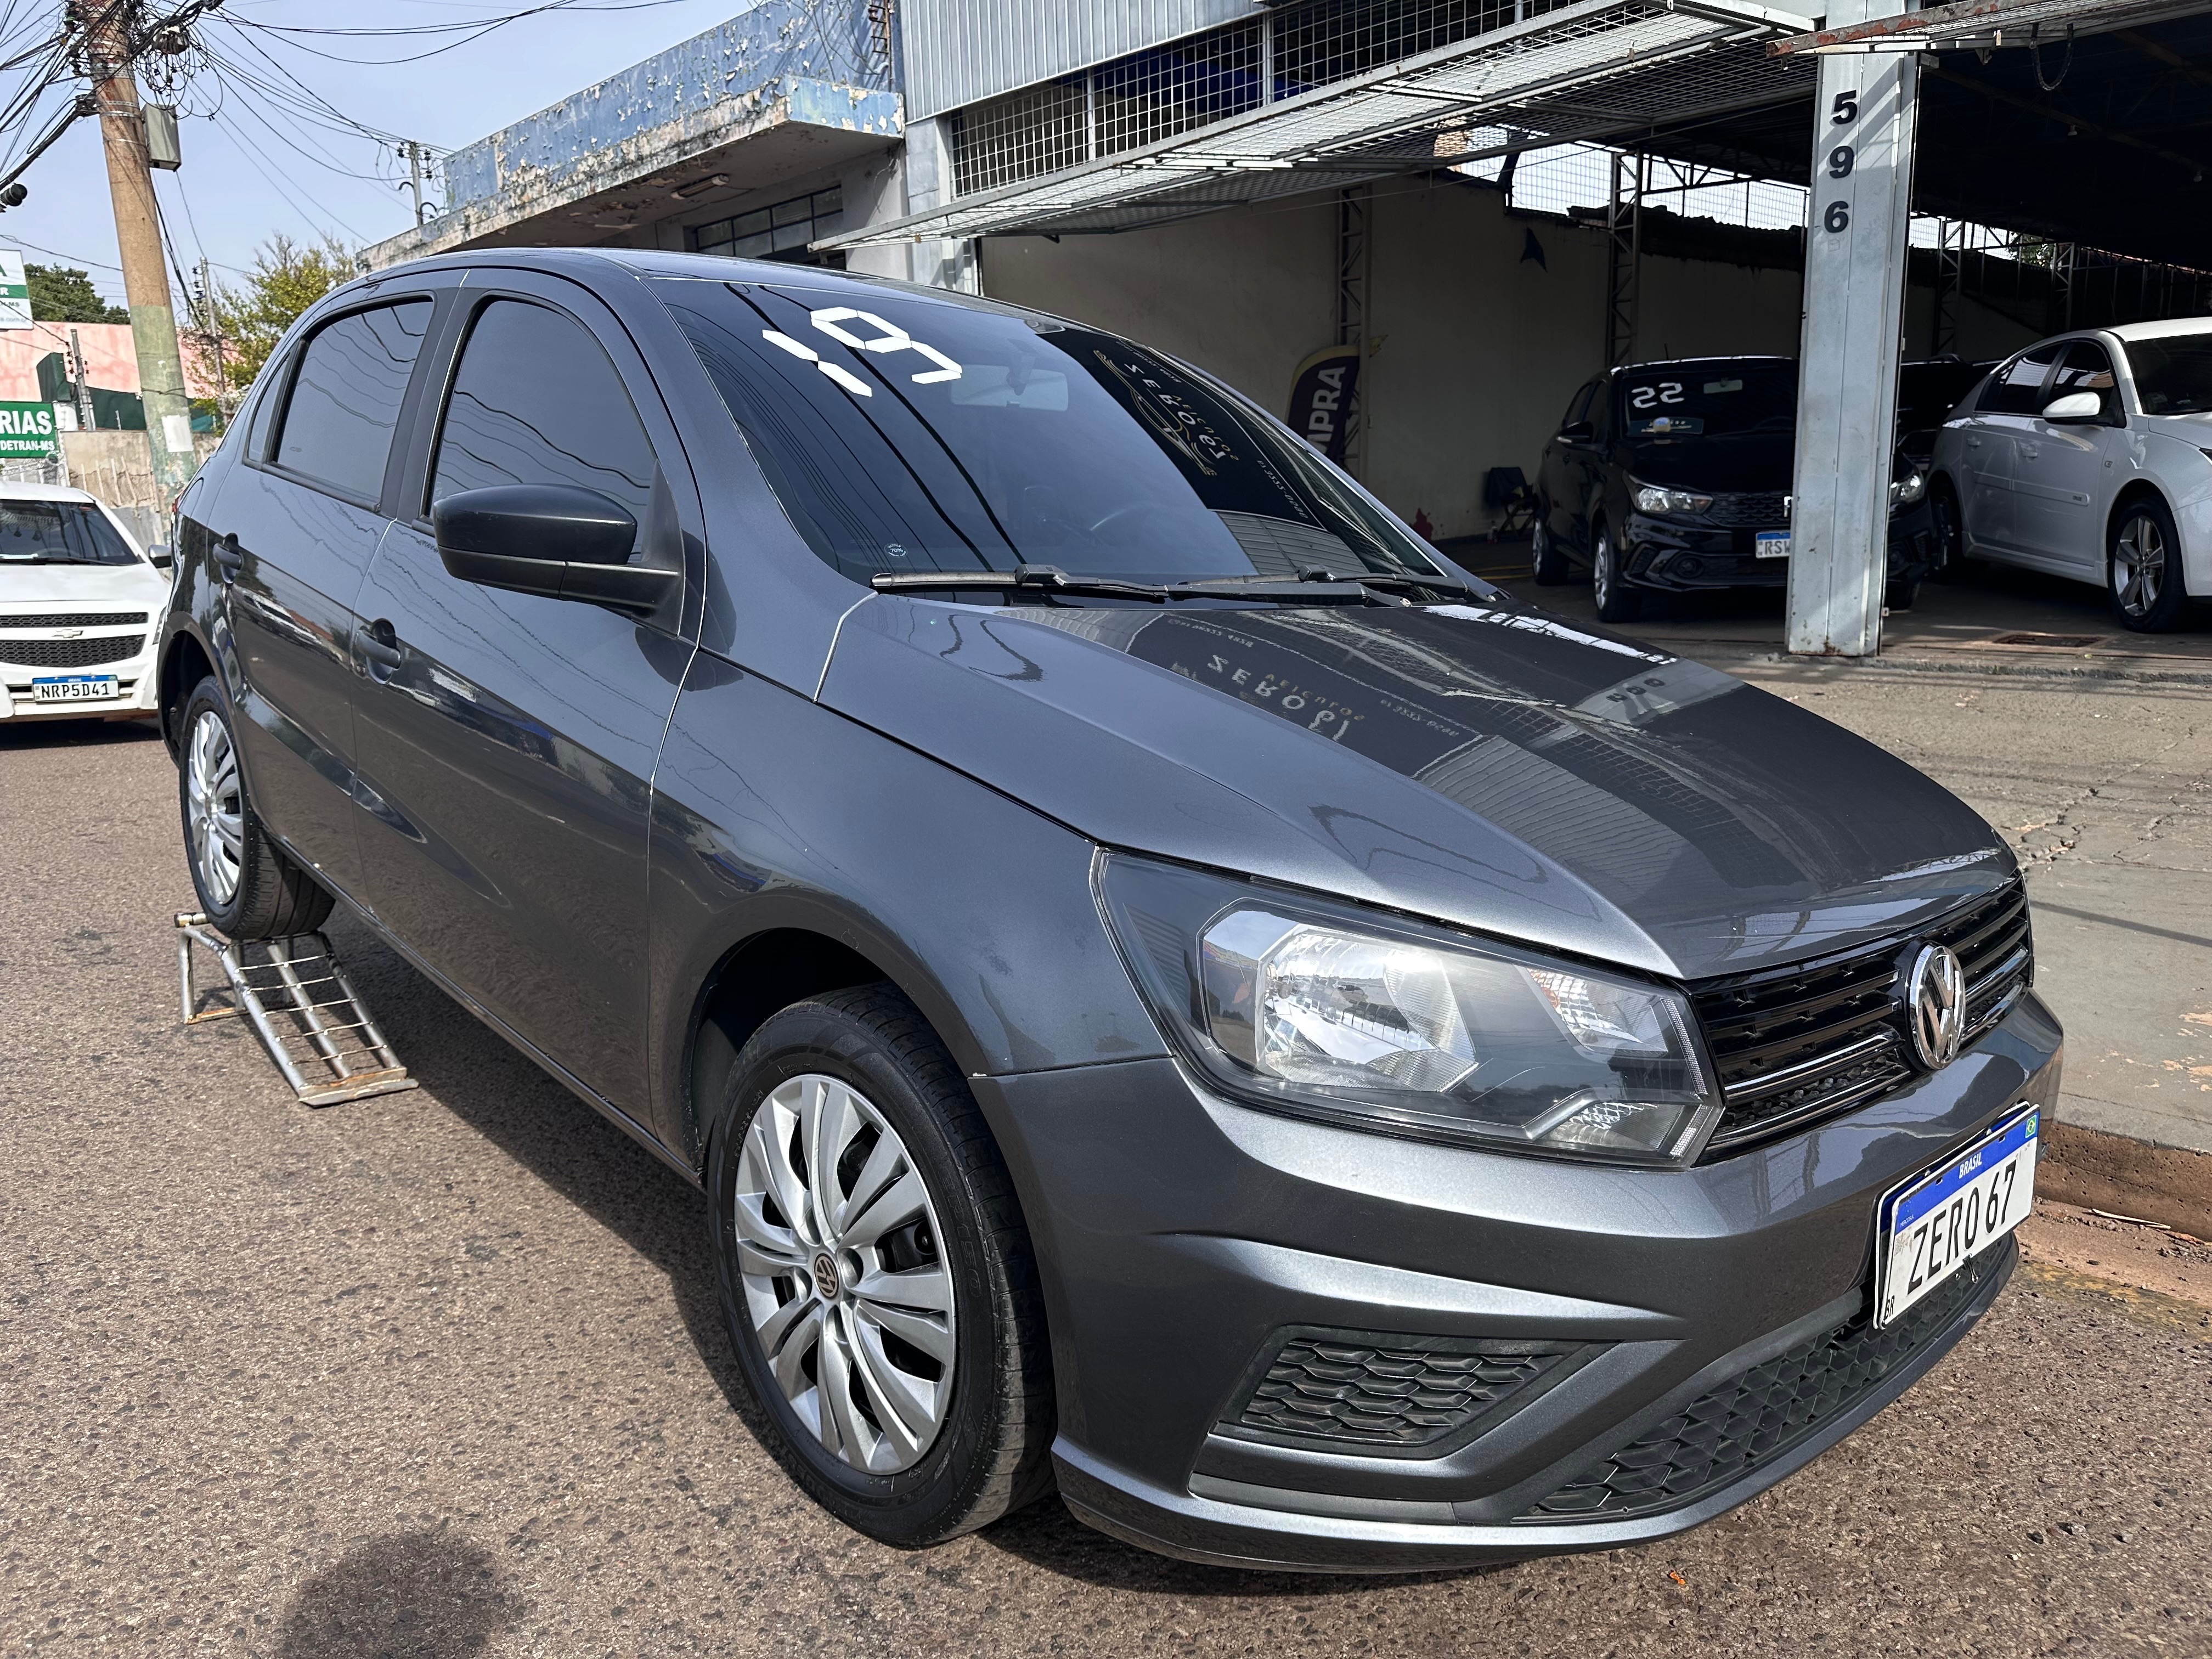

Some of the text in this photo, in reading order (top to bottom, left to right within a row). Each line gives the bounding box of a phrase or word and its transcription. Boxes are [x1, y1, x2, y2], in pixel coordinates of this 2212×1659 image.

[762, 306, 963, 397] 19
[1631, 382, 1684, 408] 22
[0, 440, 55, 451] DETRAN-MS
[41, 683, 110, 698] NRP5D41
[1959, 1152, 1982, 1179] BRASIL
[1908, 1159, 2016, 1295] ZERO 67
